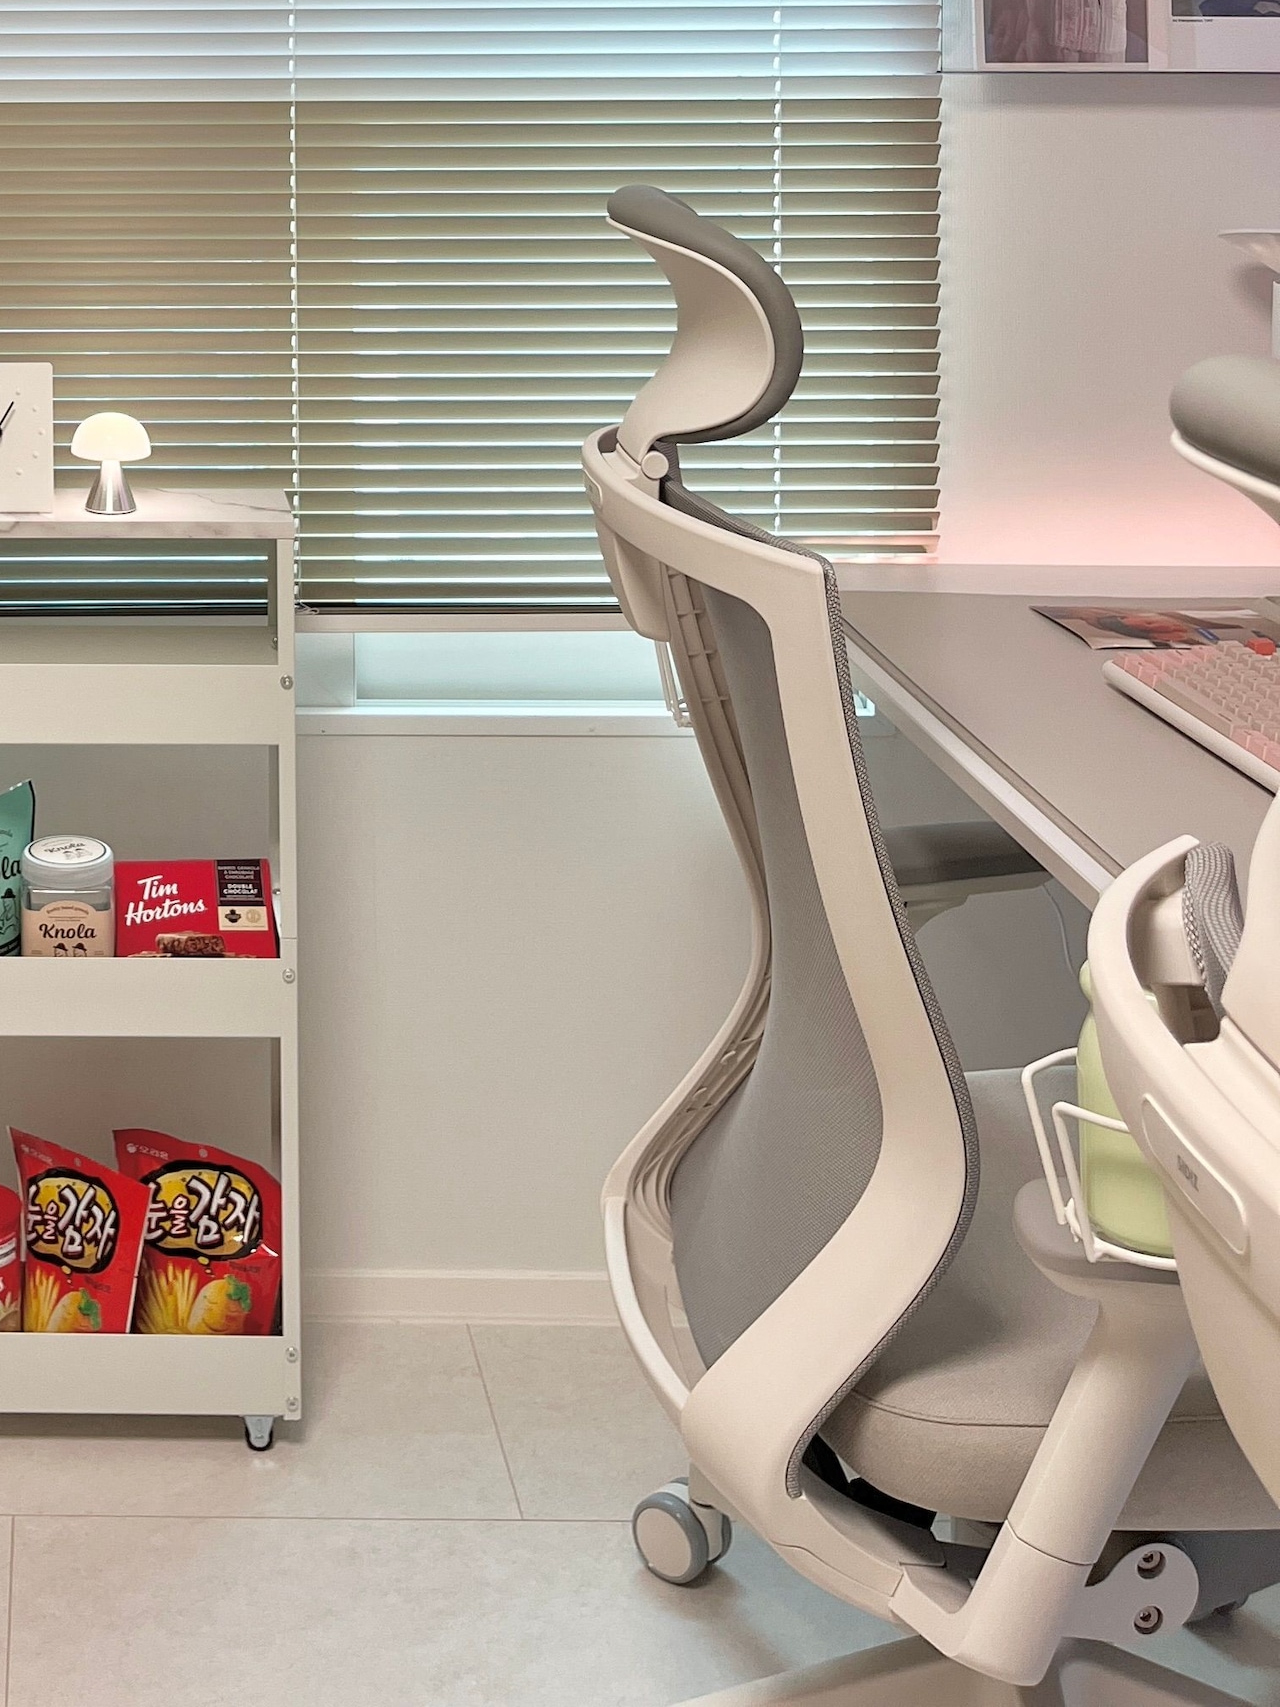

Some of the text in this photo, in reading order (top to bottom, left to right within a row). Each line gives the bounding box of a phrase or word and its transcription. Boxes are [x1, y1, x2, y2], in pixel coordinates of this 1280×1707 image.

[136, 874, 179, 901] Tim
[125, 898, 205, 927] Hortons
[39, 923, 98, 939] Knola
